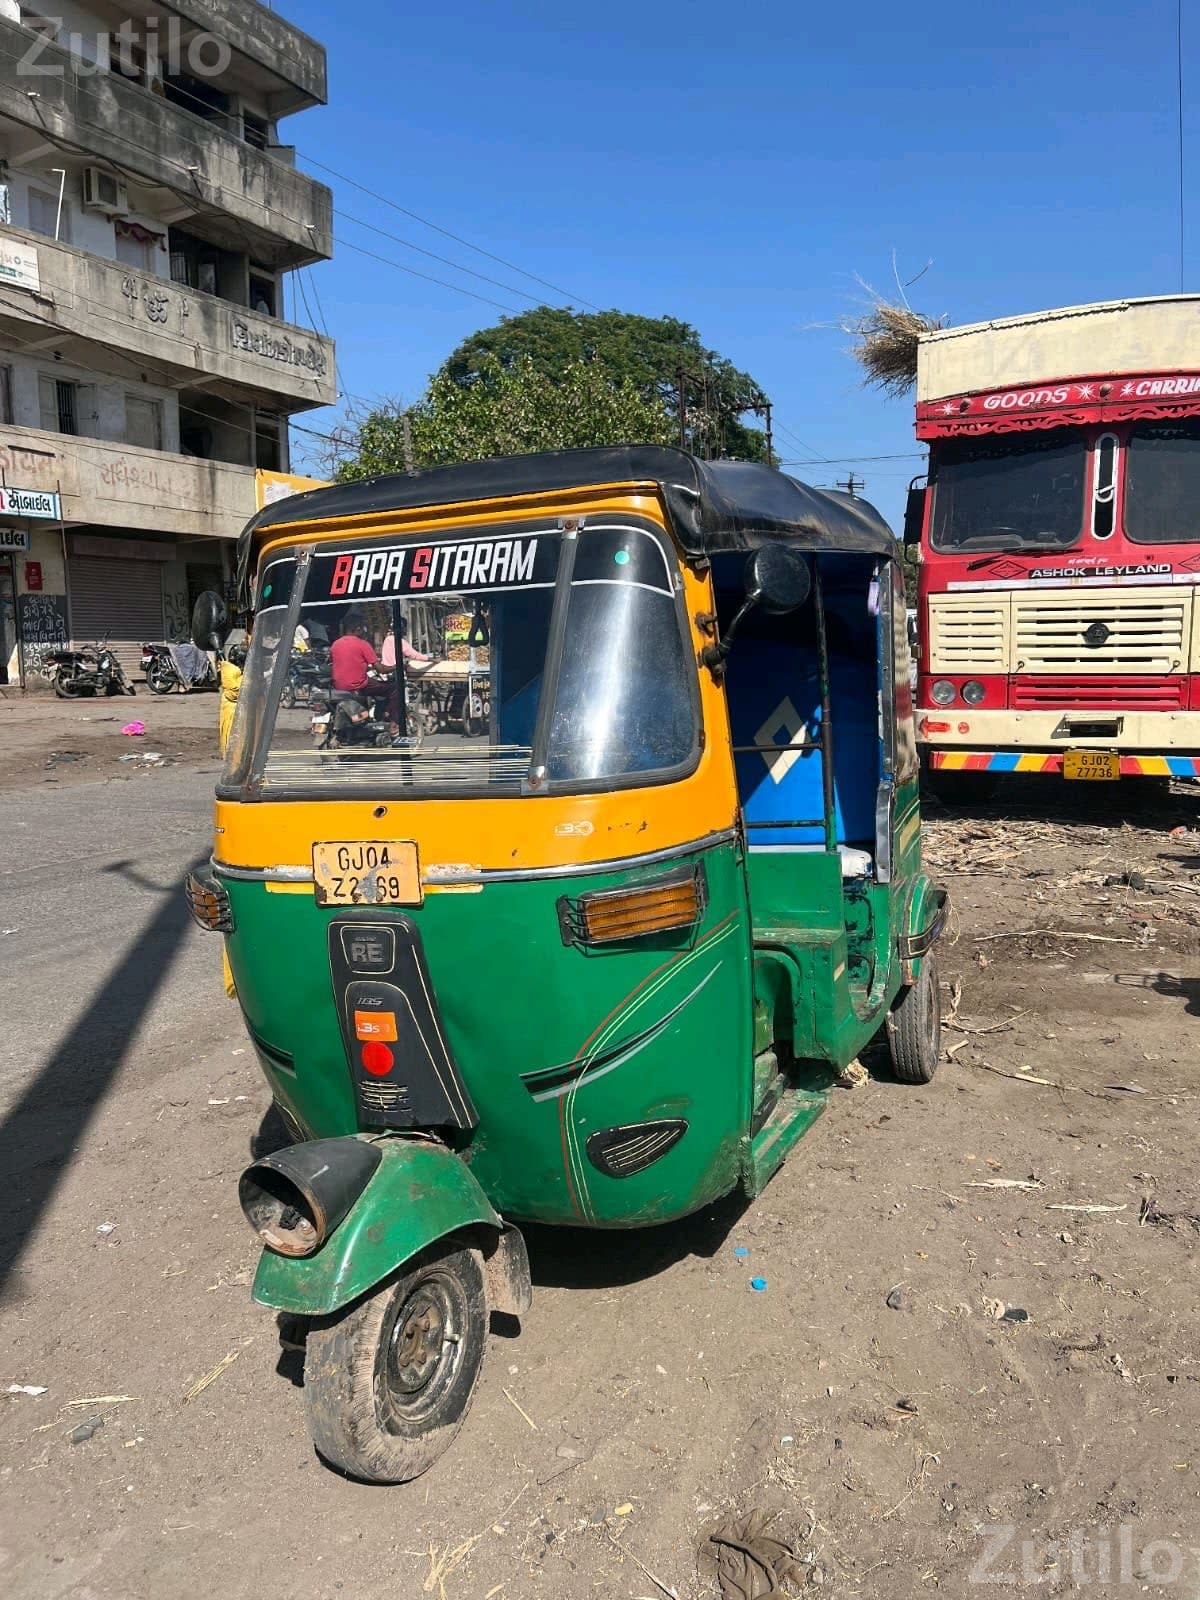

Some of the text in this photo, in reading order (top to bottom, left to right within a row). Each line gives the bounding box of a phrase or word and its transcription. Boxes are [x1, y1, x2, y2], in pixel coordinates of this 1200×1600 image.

[983, 387, 1071, 410] GOODS
[329, 538, 539, 596] BAPA SITARAM
[1031, 564, 1172, 578] ASHOK LEYLAND
[1081, 755, 1110, 766] GJ02
[1077, 767, 1113, 778] Z7736
[337, 846, 393, 871] GJ04
[331, 875, 400, 900] Z269
[351, 942, 384, 963] RE
